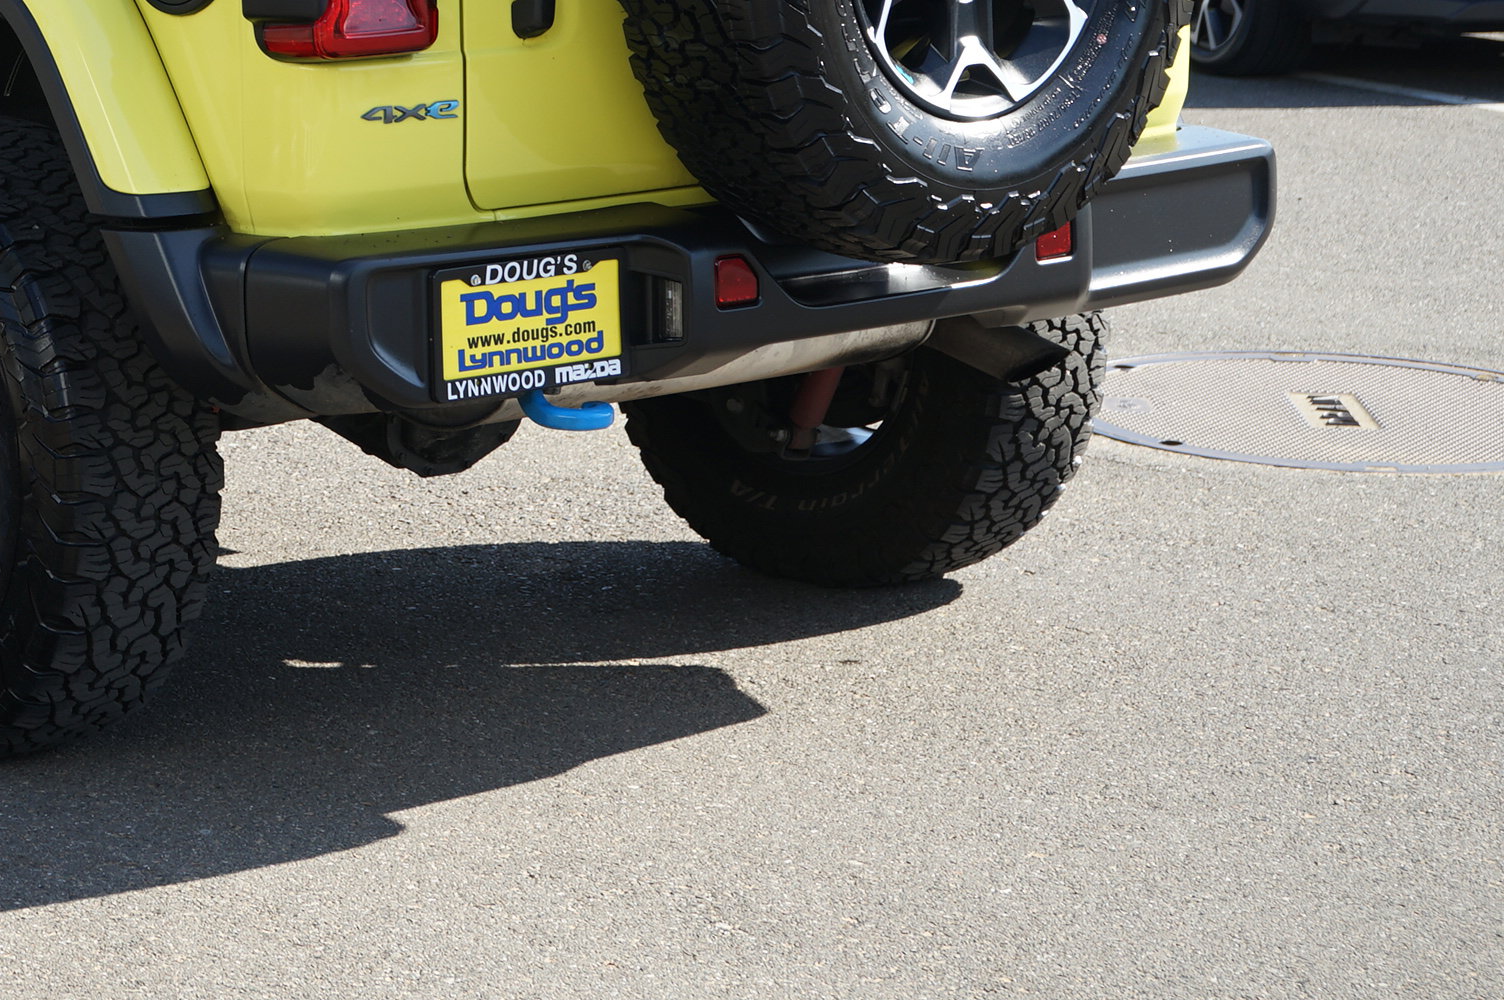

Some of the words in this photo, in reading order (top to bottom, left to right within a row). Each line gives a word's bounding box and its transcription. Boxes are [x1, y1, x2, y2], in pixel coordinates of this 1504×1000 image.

[485, 254, 577, 285] DOUG'S
[460, 279, 597, 326] Doug's
[467, 320, 596, 349] www.dougs.com
[458, 331, 604, 372] Lynnwood
[447, 369, 546, 400] LYNNWOOD
